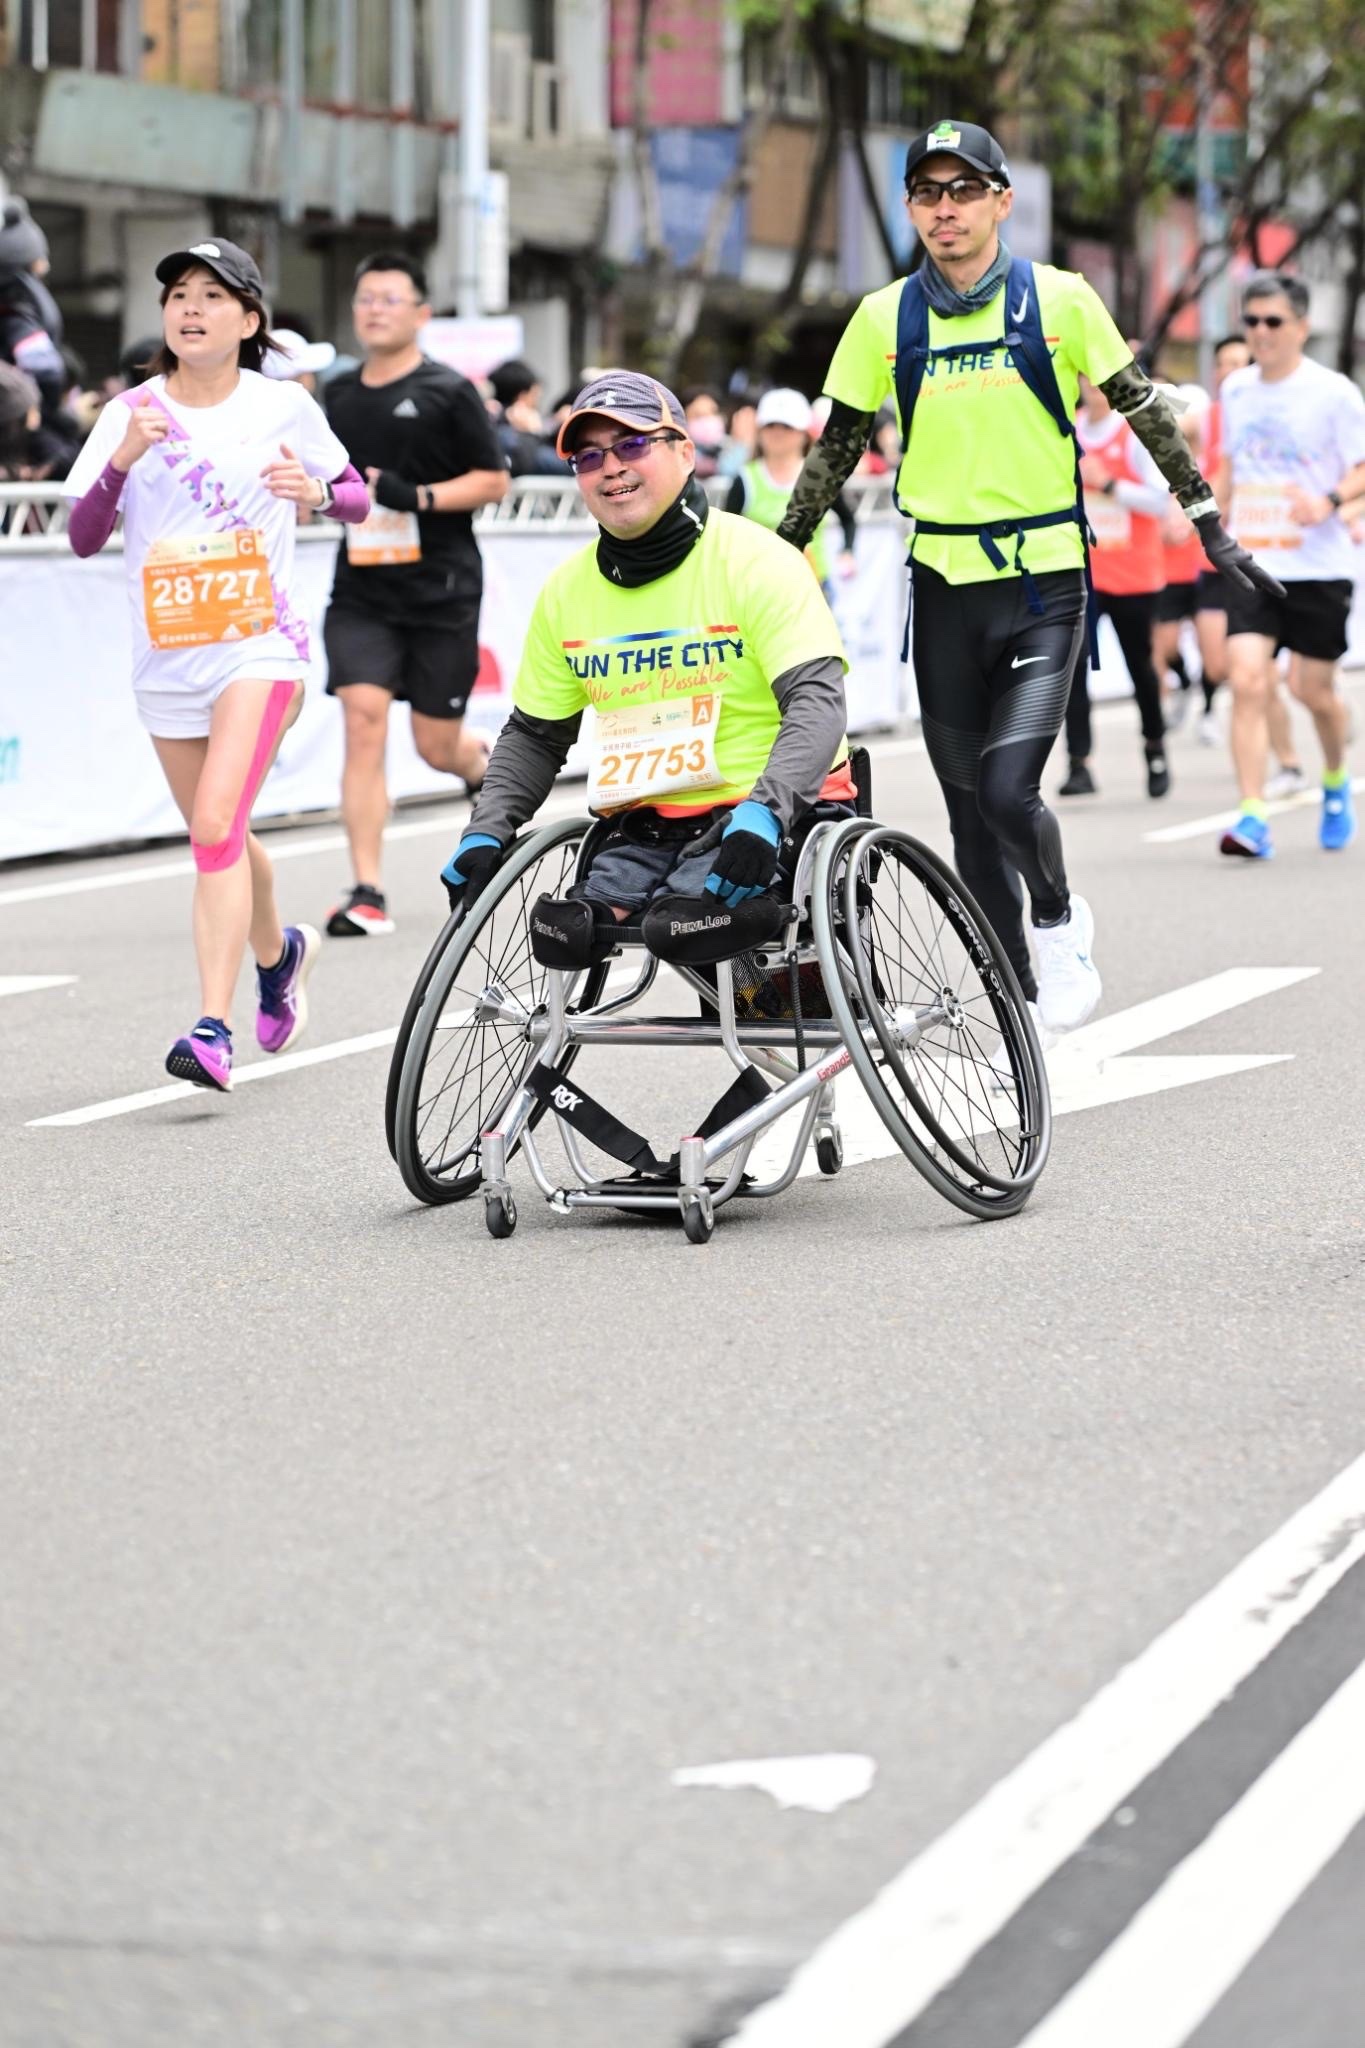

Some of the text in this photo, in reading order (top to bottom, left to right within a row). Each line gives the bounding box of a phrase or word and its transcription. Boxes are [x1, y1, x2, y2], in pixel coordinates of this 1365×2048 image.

[944, 351, 994, 374] THE
[238, 538, 254, 555] C
[151, 568, 261, 609] 28727
[616, 645, 673, 675] THE
[681, 638, 743, 668] CITY
[584, 655, 729, 704] We are Possible
[694, 703, 711, 723] A
[597, 739, 706, 787] 27753
